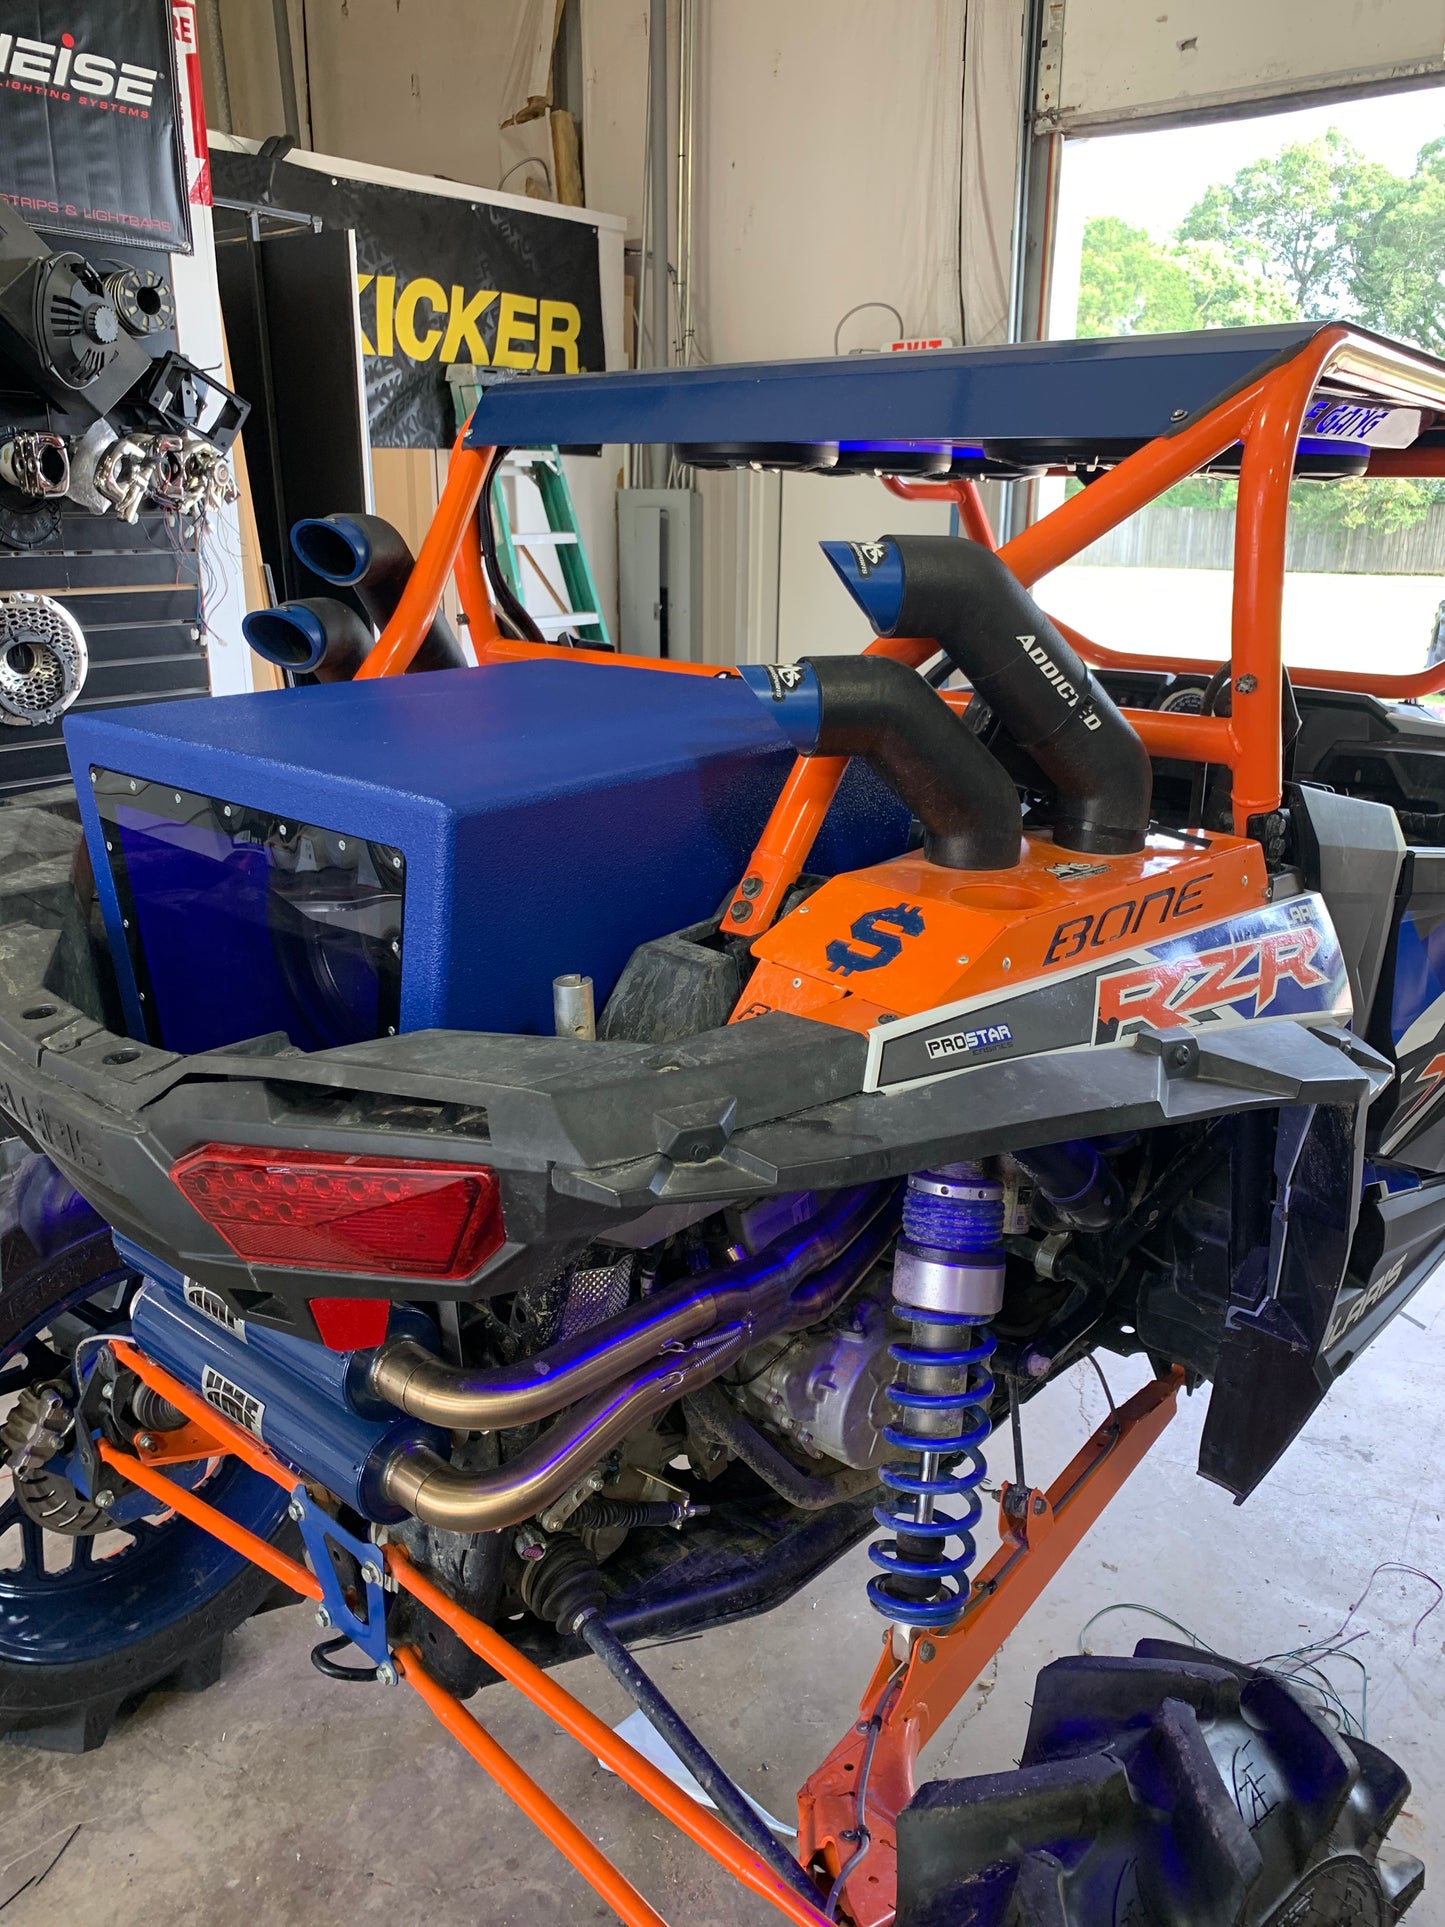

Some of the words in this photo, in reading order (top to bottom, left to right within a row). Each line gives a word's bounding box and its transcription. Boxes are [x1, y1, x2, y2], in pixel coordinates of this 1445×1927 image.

[78, 95, 150, 119] SYSTEMS
[65, 204, 78, 216] &
[83, 207, 173, 232] LIGHTBARS
[1015, 634, 1102, 731] ADDICTD
[1042, 872, 1214, 967] BONE
[1095, 926, 1330, 1046] RZR
[927, 1025, 1012, 1056] PROSTAR
